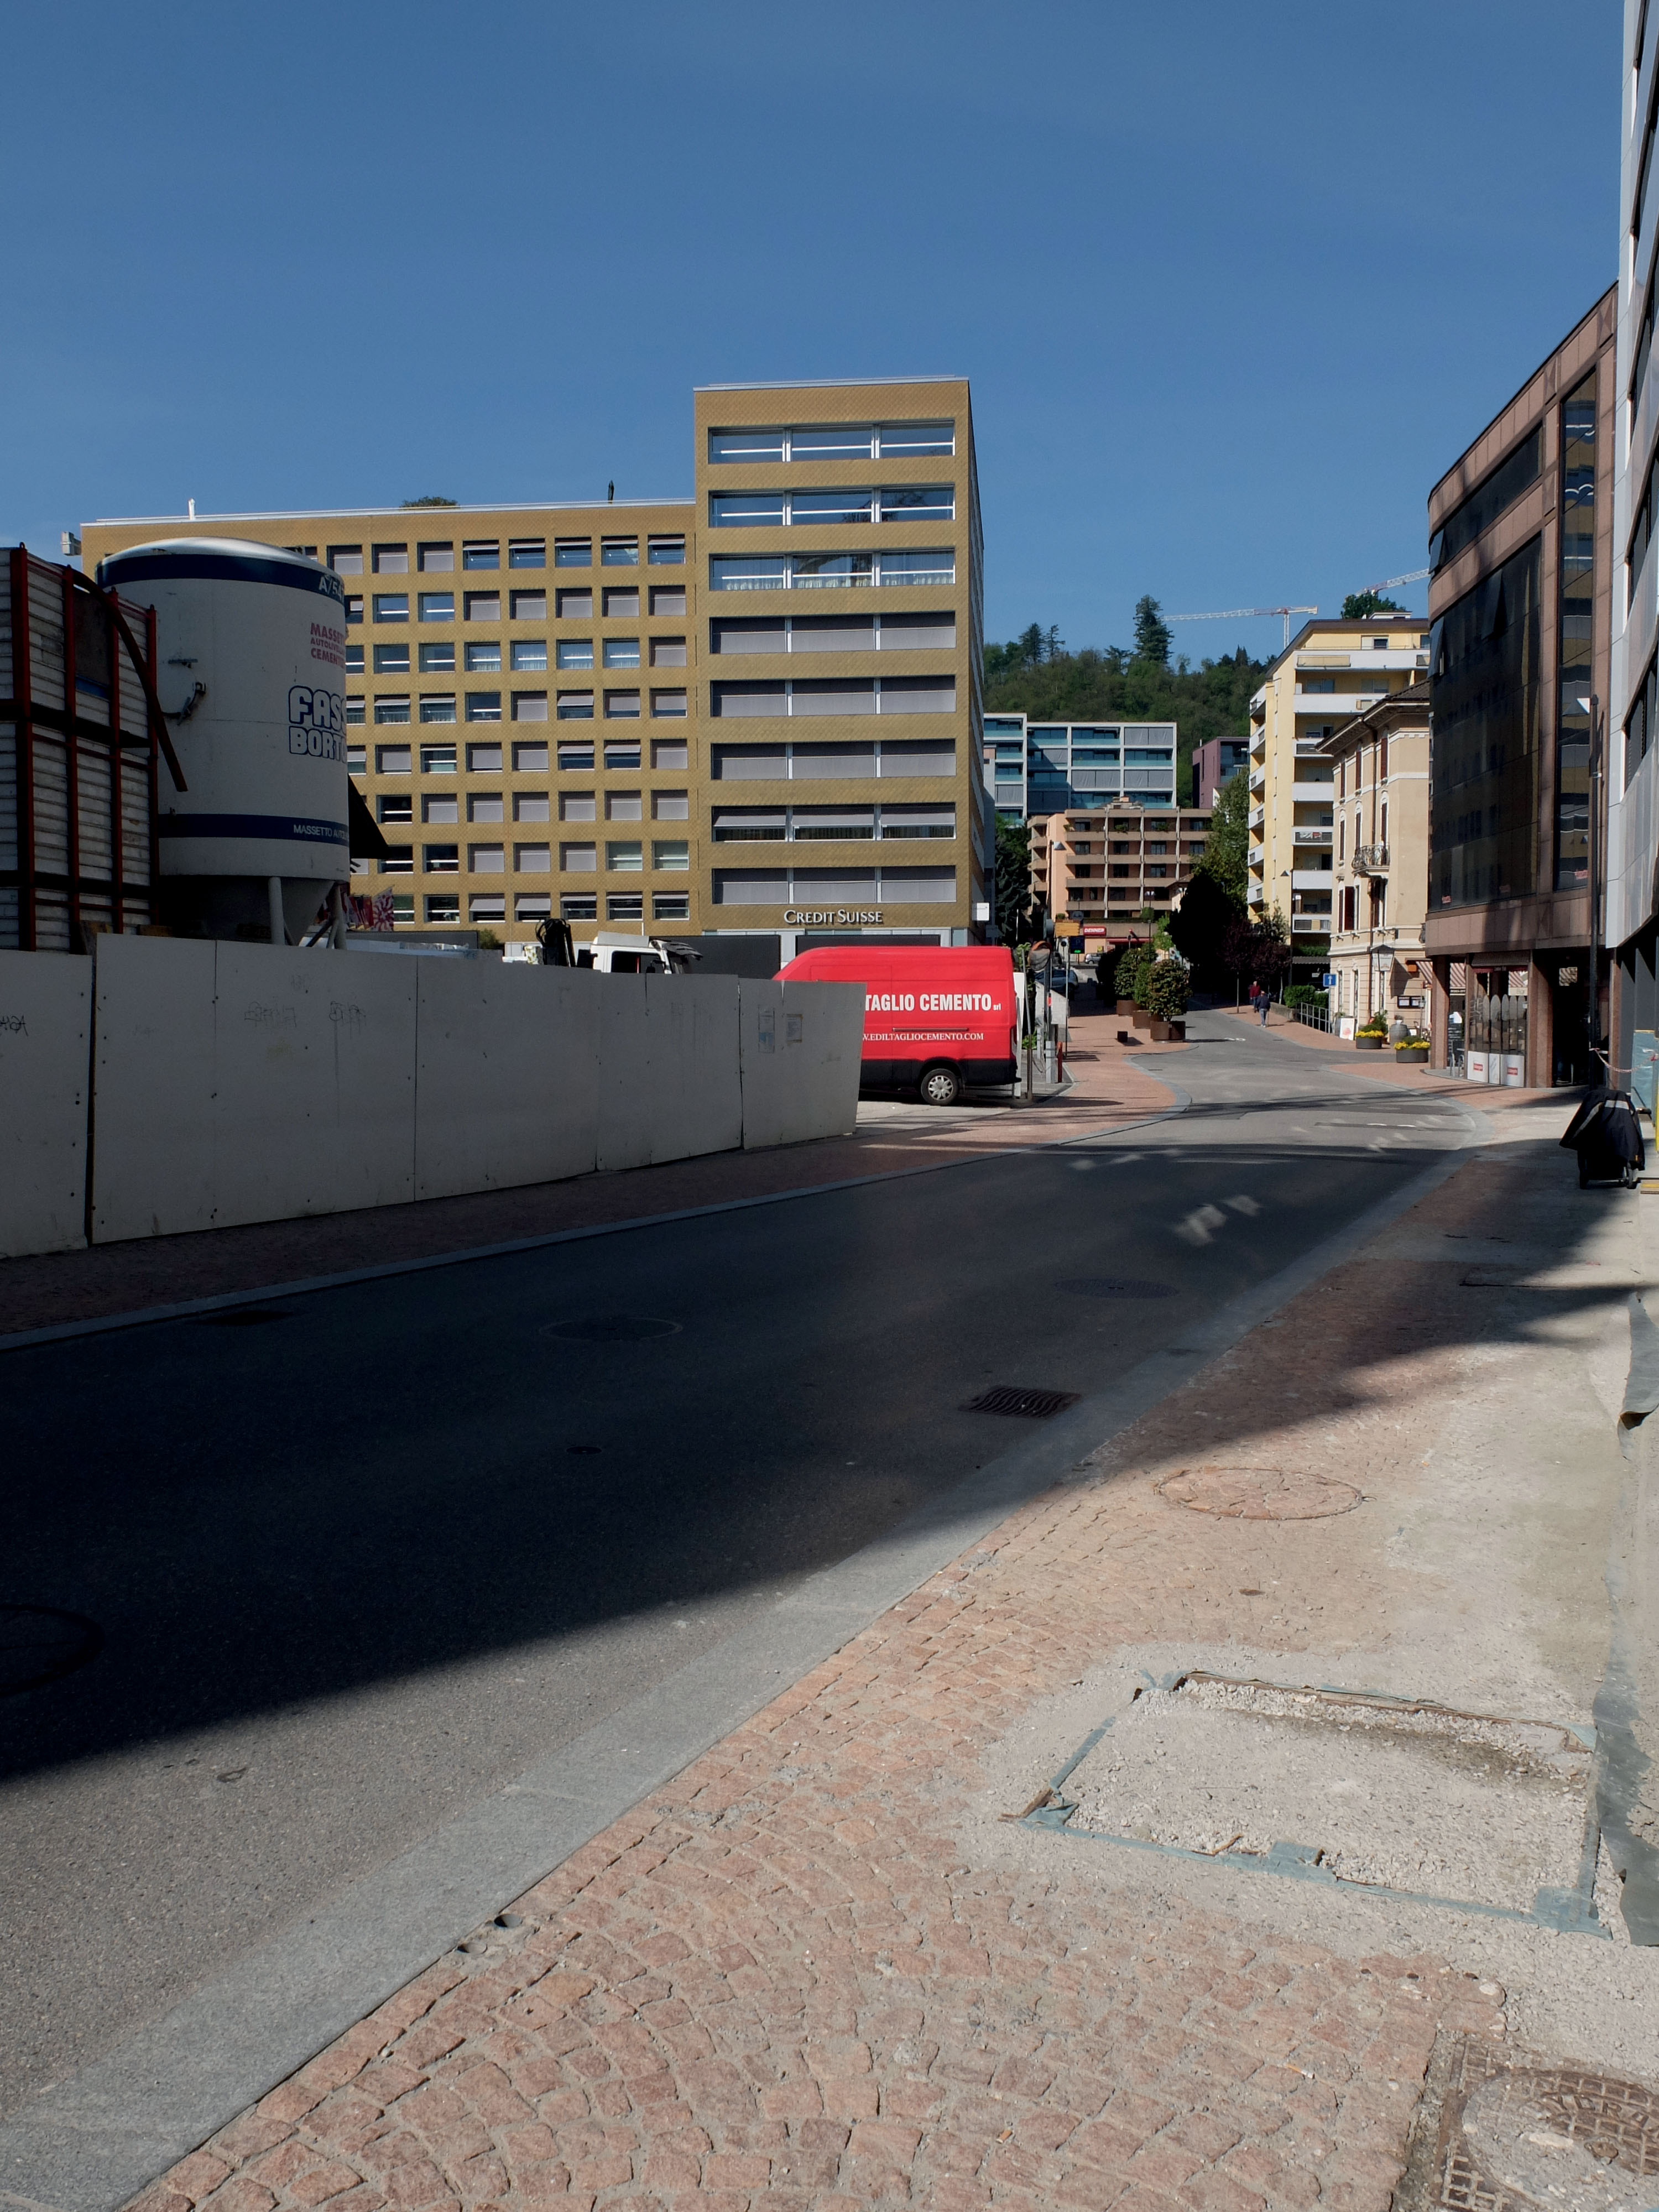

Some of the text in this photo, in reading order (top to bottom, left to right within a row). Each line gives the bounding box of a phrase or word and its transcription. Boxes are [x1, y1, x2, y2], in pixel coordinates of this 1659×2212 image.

[293, 825, 332, 837] MASSETTO
[784, 909, 883, 924] CREDIT SUISSE
[920, 994, 992, 1011] CEMENTO
